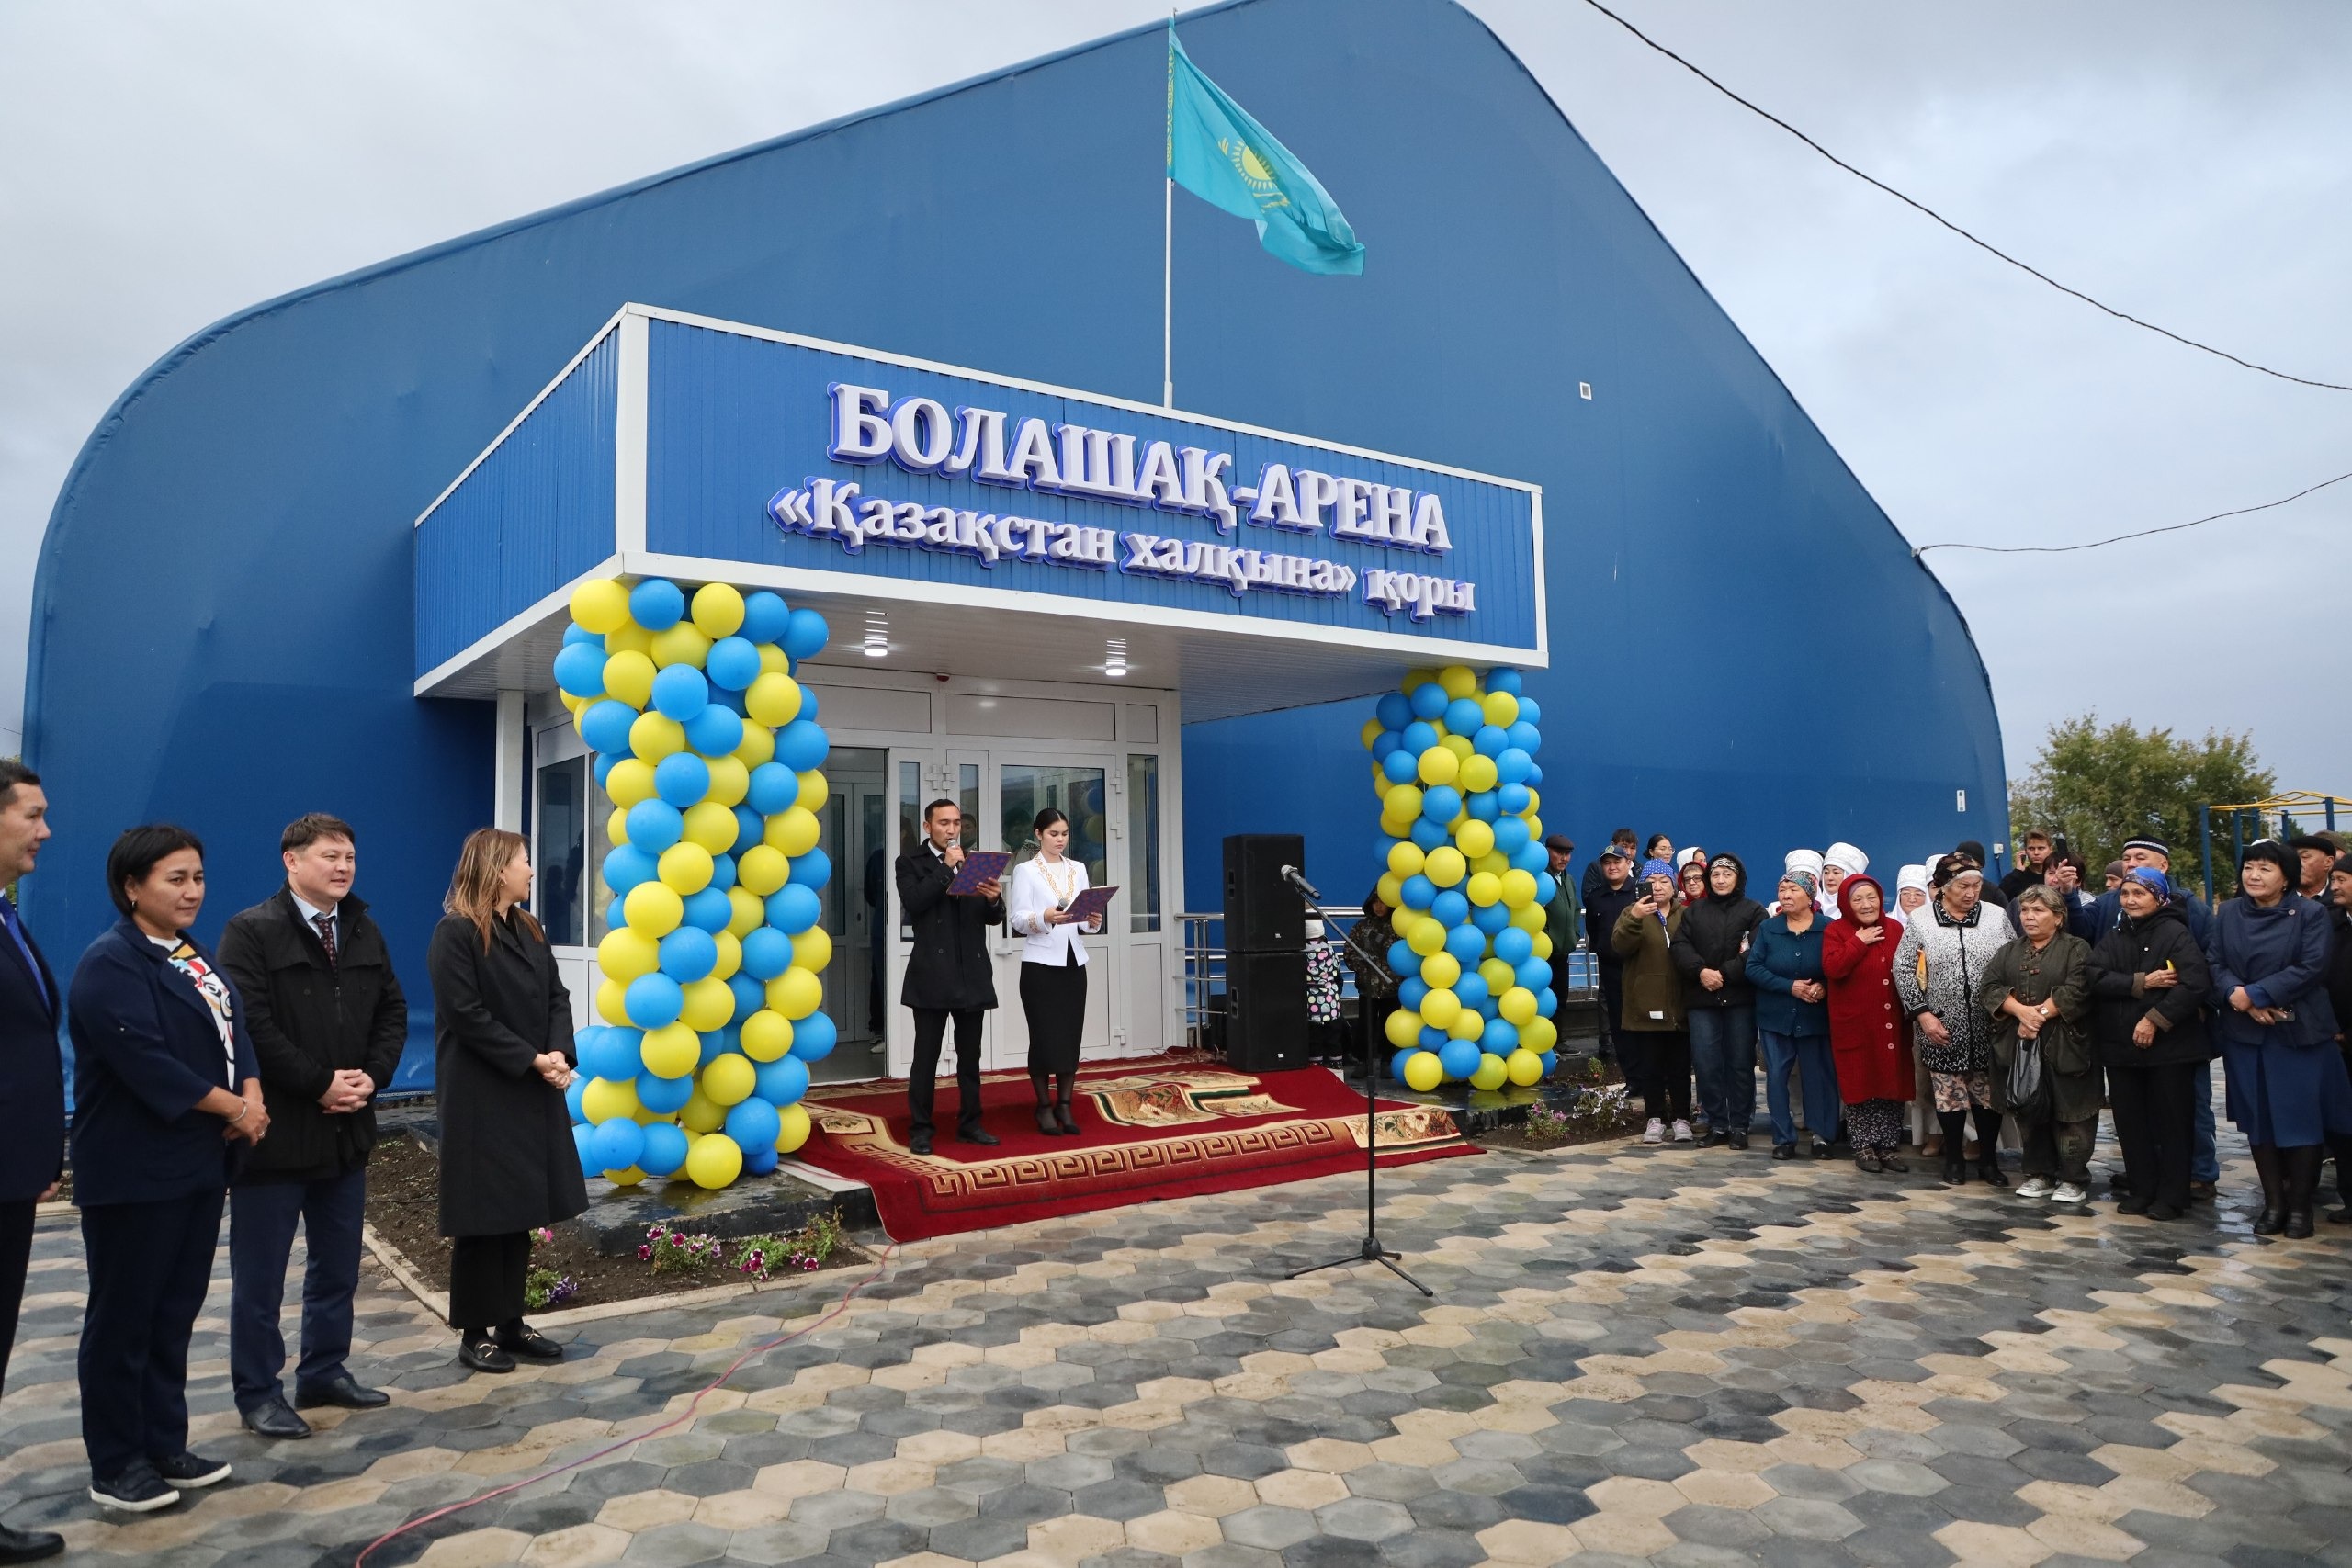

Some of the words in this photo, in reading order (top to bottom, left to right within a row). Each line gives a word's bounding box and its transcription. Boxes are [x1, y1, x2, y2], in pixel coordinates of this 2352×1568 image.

[831, 382, 1453, 550] БОЛАШАҚ-АРЕНА
[774, 478, 1116, 564] «Қазақстан
[1123, 533, 1357, 592] халқына»
[1365, 569, 1476, 616] қоры
